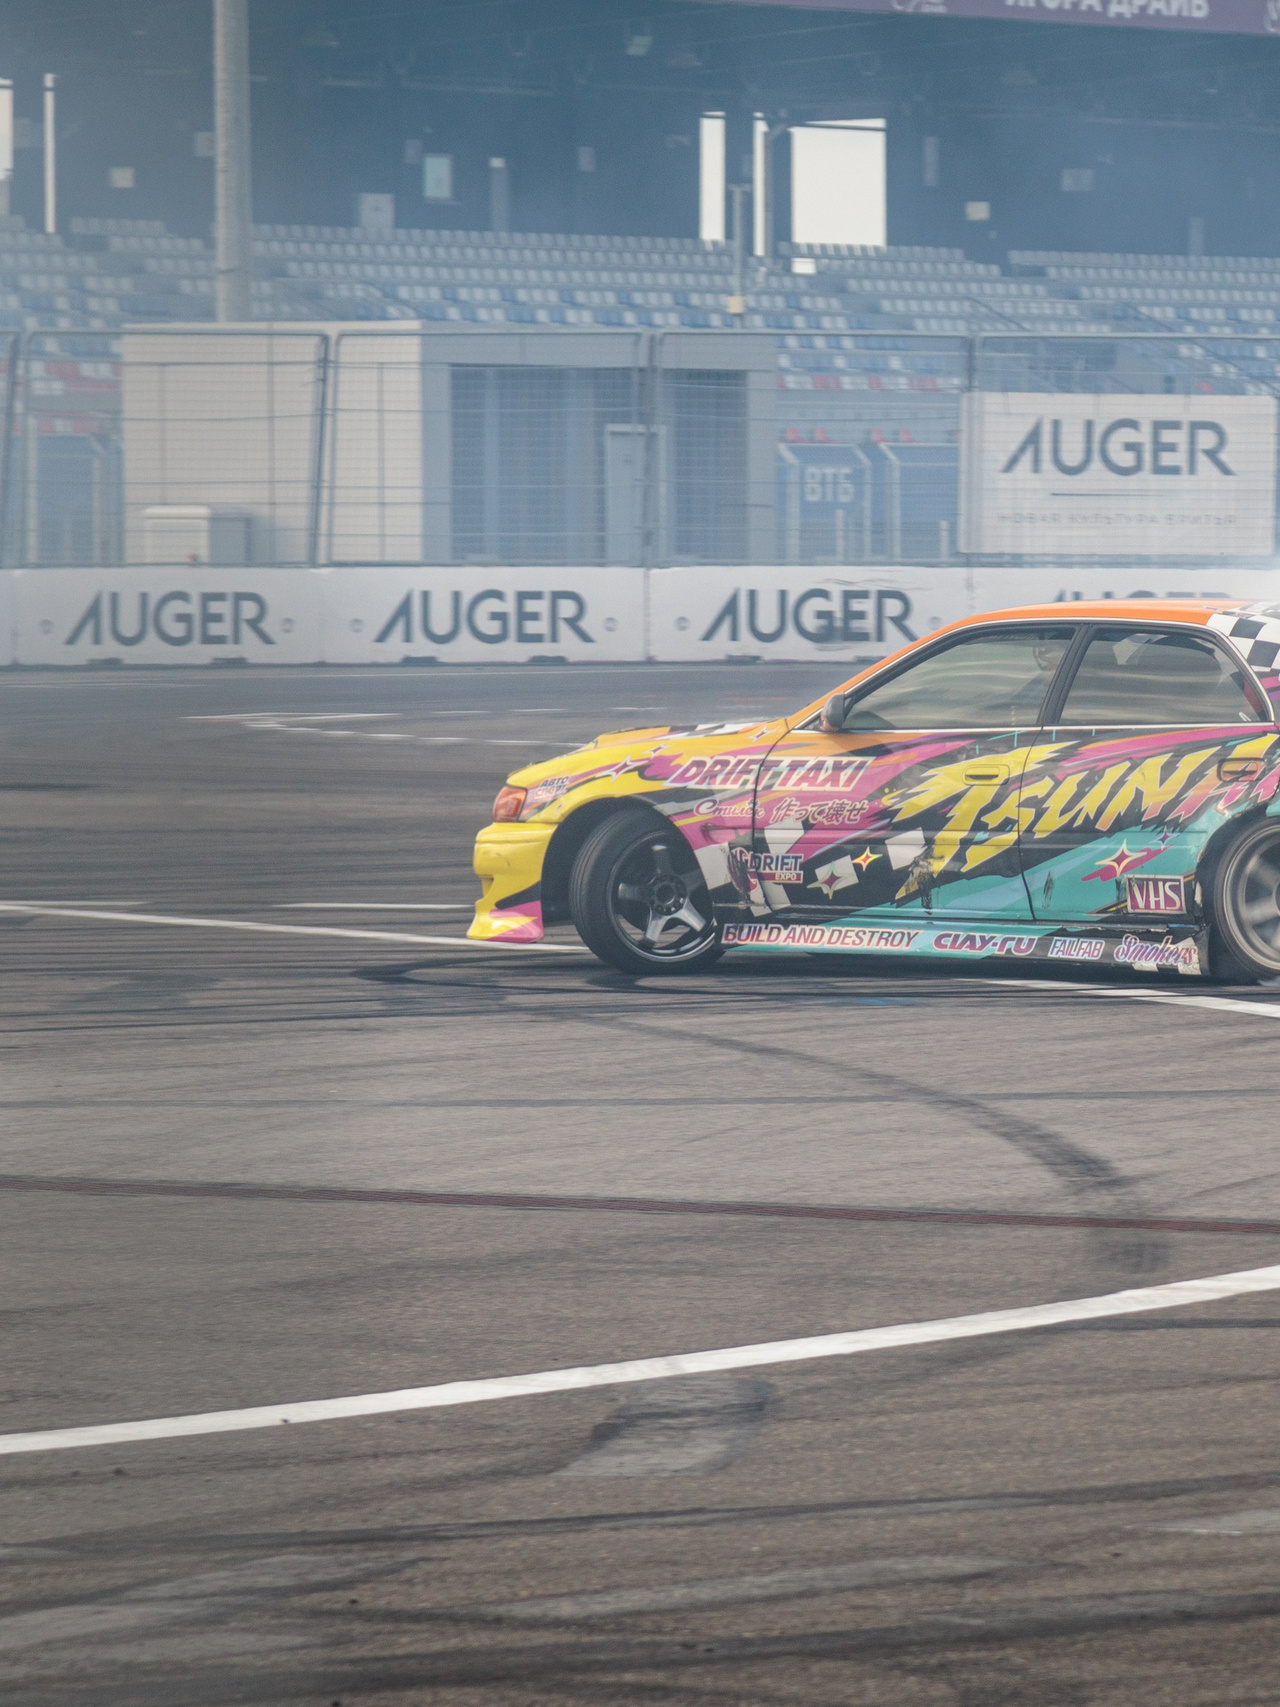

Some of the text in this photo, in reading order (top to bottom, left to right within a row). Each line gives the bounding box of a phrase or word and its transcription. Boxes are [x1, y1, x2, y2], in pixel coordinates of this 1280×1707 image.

[1001, 416, 1238, 477] AUGER
[64, 590, 277, 646] AUGER
[373, 589, 597, 644] AUGER
[700, 588, 919, 643] AUGER
[666, 757, 875, 791] DRIFT TAXI
[748, 854, 803, 871] DRIFT
[775, 873, 797, 881] EXPO
[1130, 878, 1181, 910] VHS
[722, 924, 921, 949] BUILD AND DESTROY
[1114, 934, 1197, 965] Smokers
